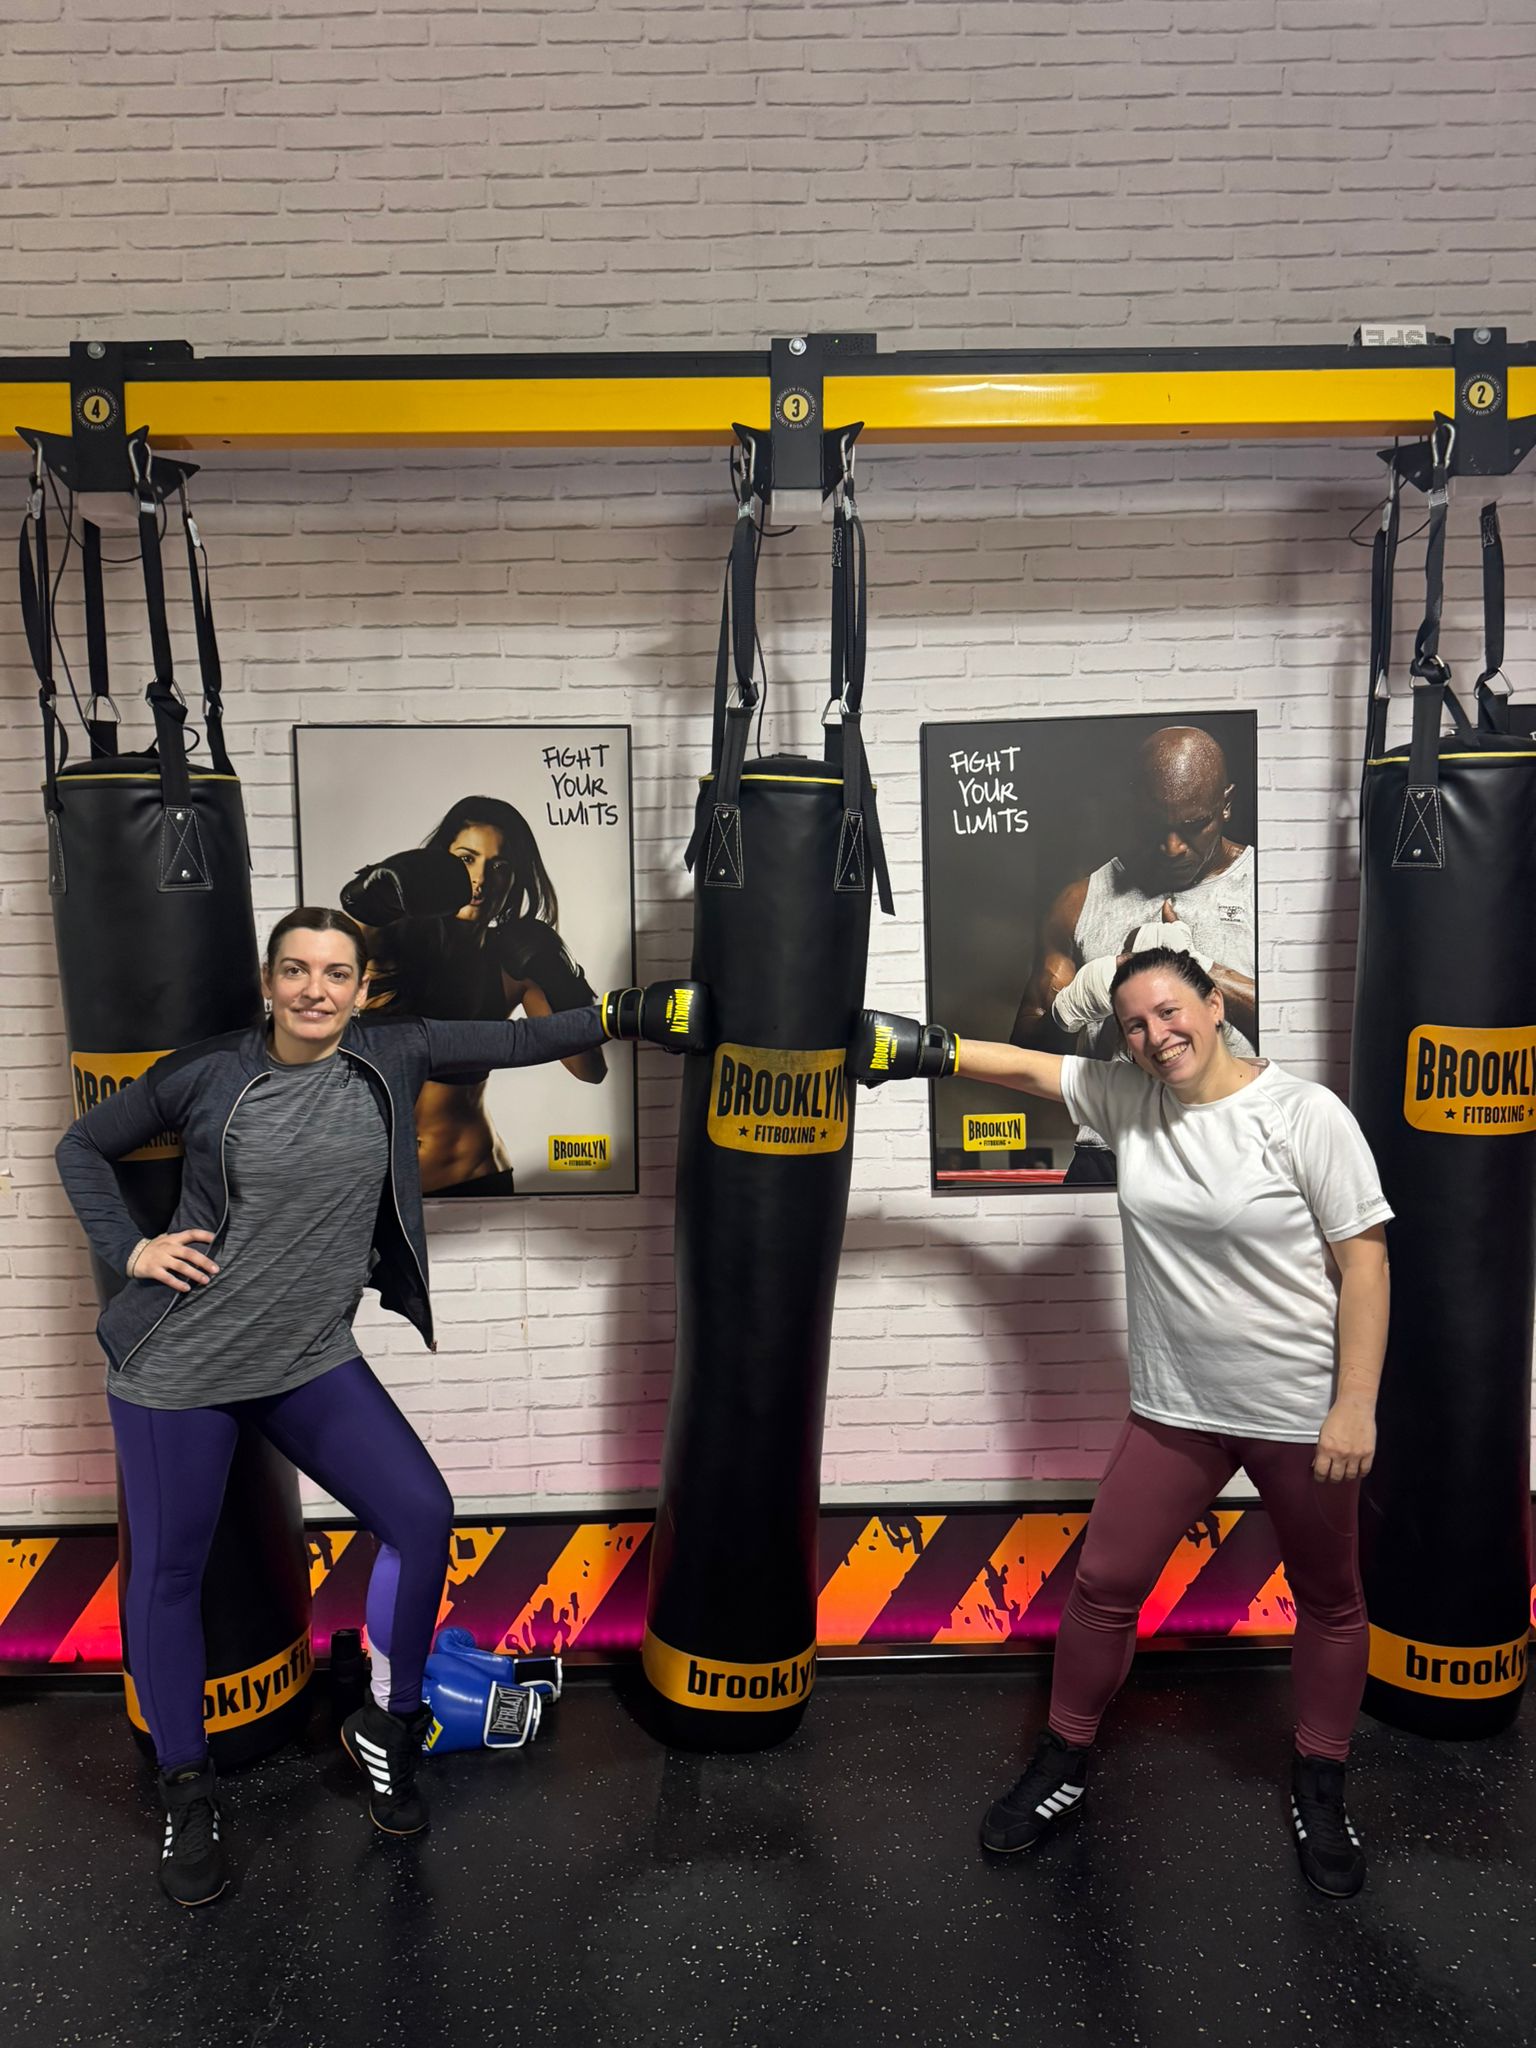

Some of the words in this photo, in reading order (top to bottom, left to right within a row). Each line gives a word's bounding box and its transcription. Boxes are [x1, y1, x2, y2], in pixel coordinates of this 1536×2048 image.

[1477, 384, 1486, 404] 2
[91, 398, 101, 419] 4
[791, 398, 801, 418] 3
[541, 744, 610, 770] FIGHT
[949, 746, 1021, 775] FIGHT
[551, 772, 608, 800] YOUR
[958, 777, 1018, 807] YOUR
[546, 800, 618, 825] LIMITS
[953, 806, 1029, 834] LIMITS
[670, 988, 695, 1034] BROOKLYN
[869, 1025, 894, 1070] BROOKLYN
[716, 1054, 845, 1123] BROOKLYN
[1463, 1104, 1525, 1124] FITBOXING
[754, 1124, 816, 1144] FITBOXING
[968, 1118, 1021, 1141] BROOKLYN
[553, 1138, 607, 1161] BROOKLYN
[491, 1687, 527, 1732] EVERLAST
